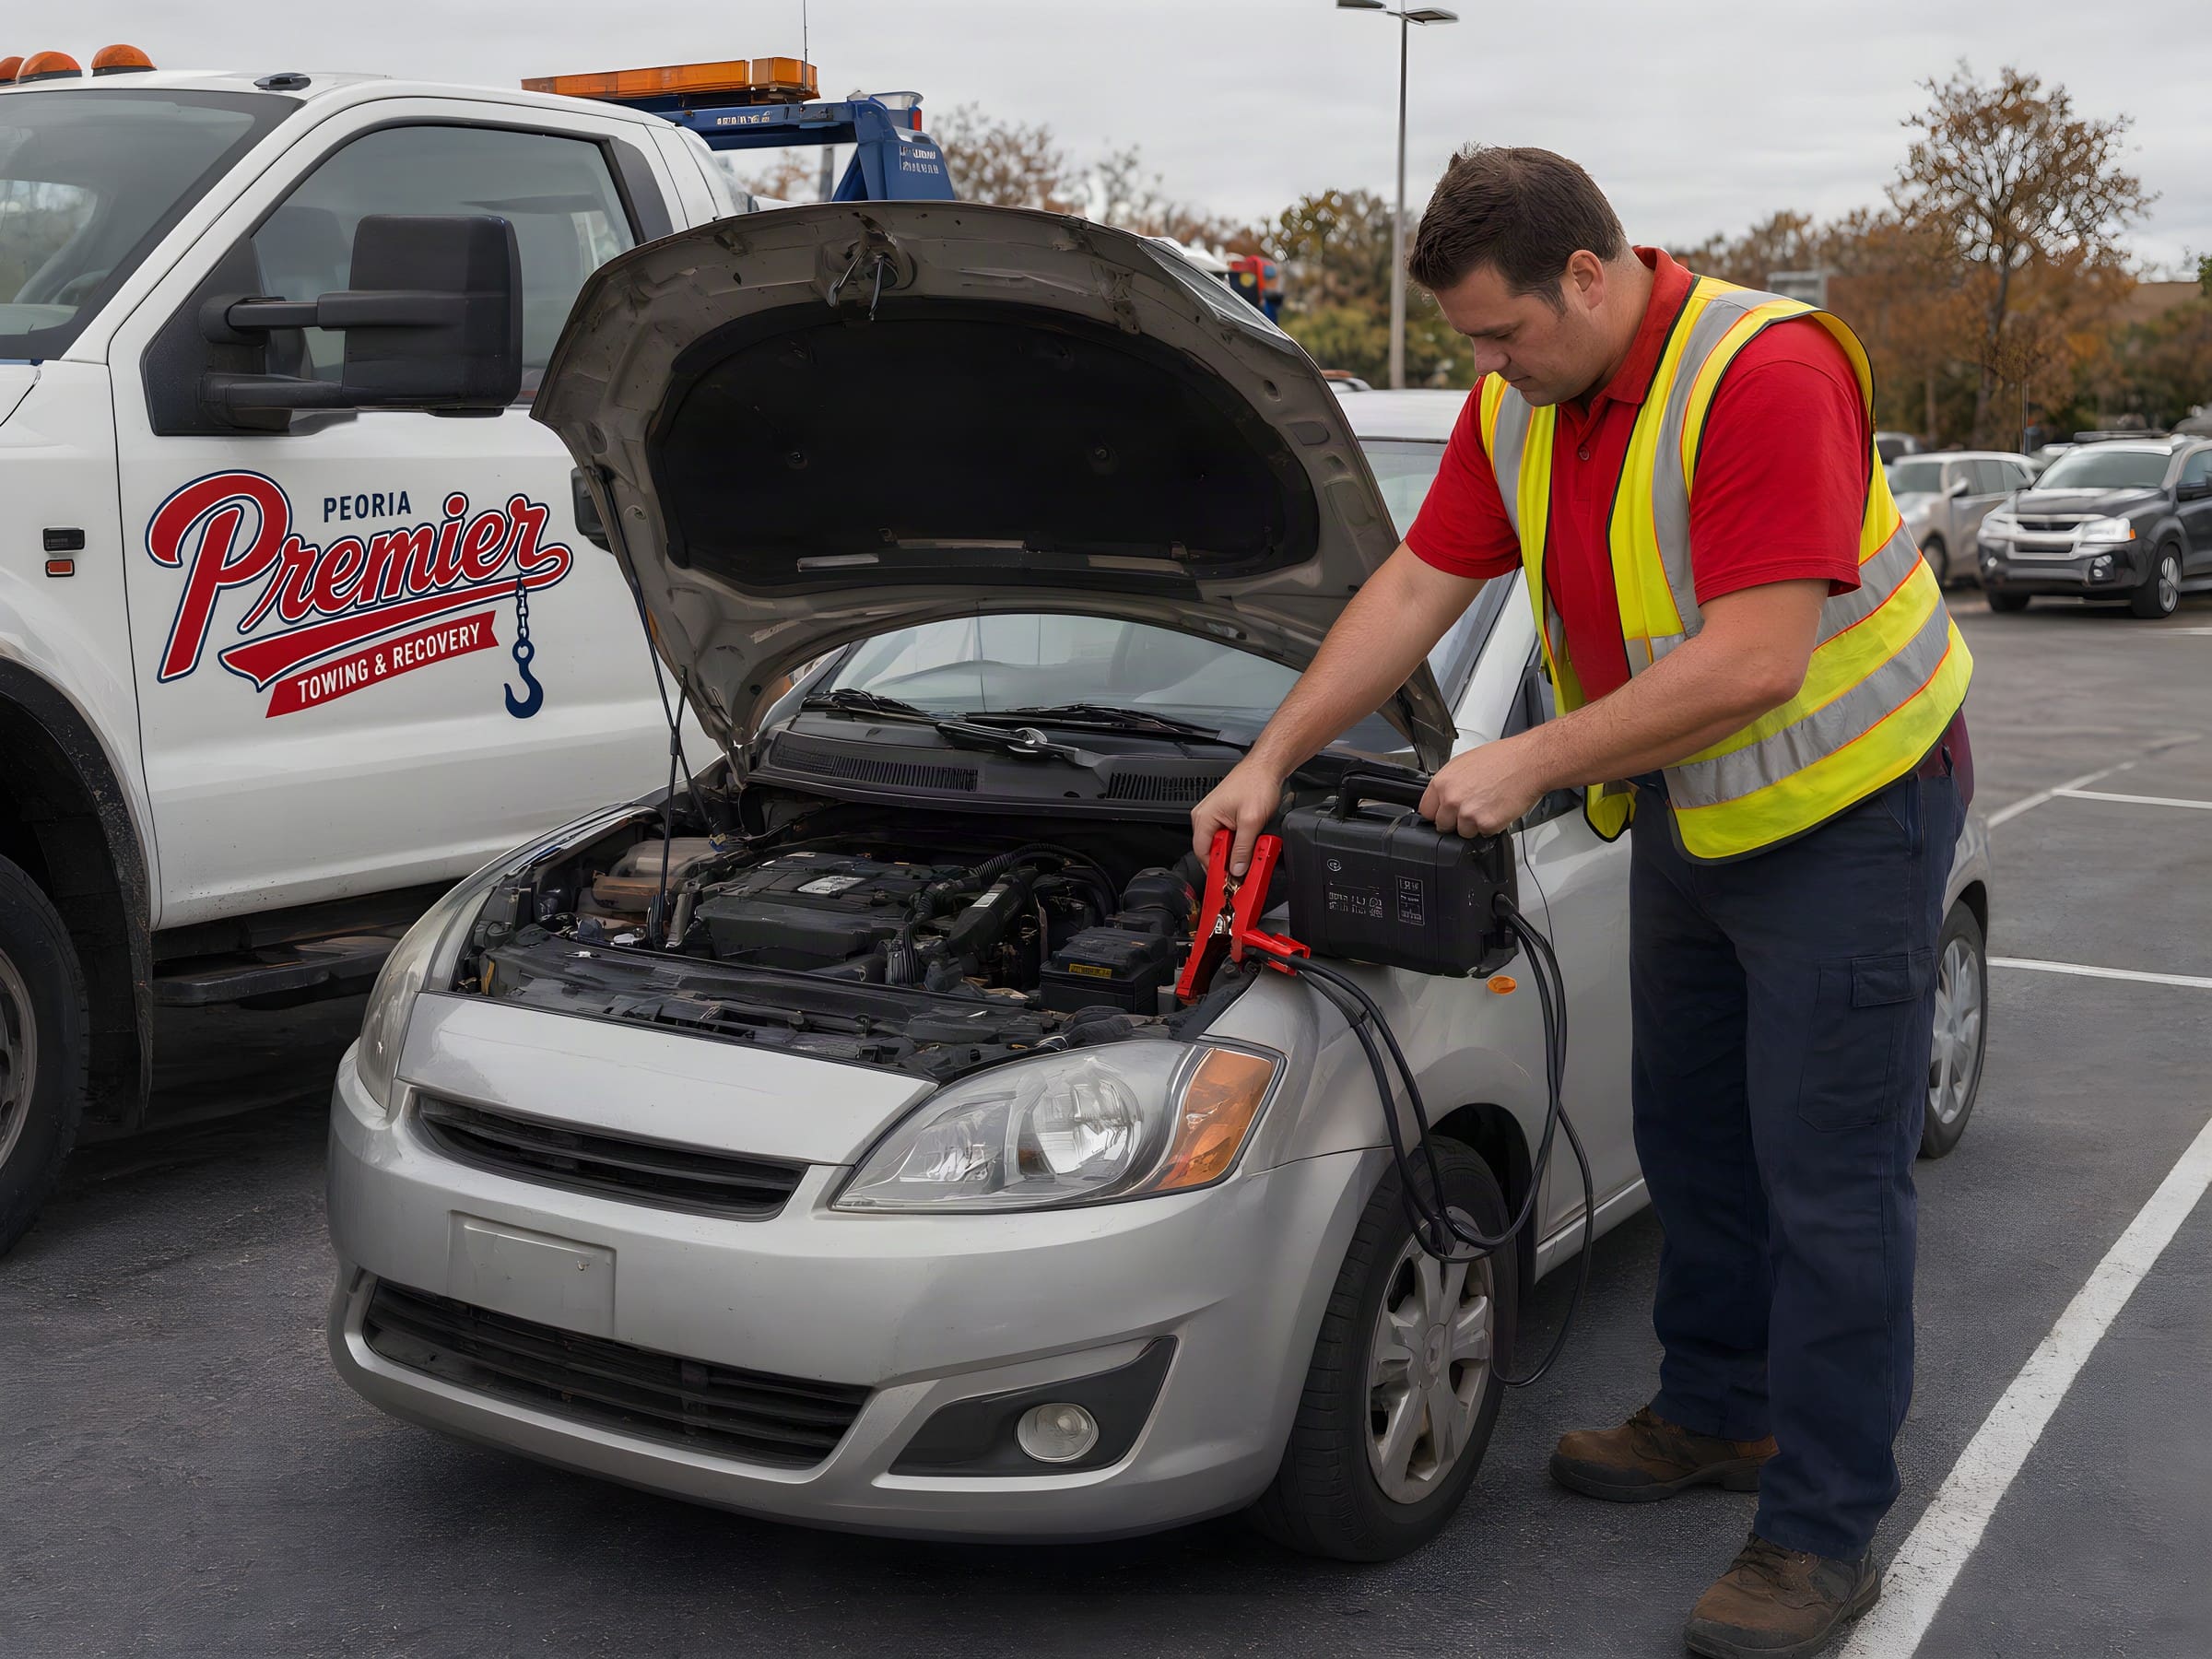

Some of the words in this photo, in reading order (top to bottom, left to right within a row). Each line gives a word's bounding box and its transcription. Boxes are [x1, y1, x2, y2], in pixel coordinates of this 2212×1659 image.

[324, 490, 412, 524] PEORIA
[145, 469, 573, 684] Premier
[297, 658, 370, 703] TOWING
[374, 653, 387, 676] &
[393, 622, 480, 669] RECOVERY
